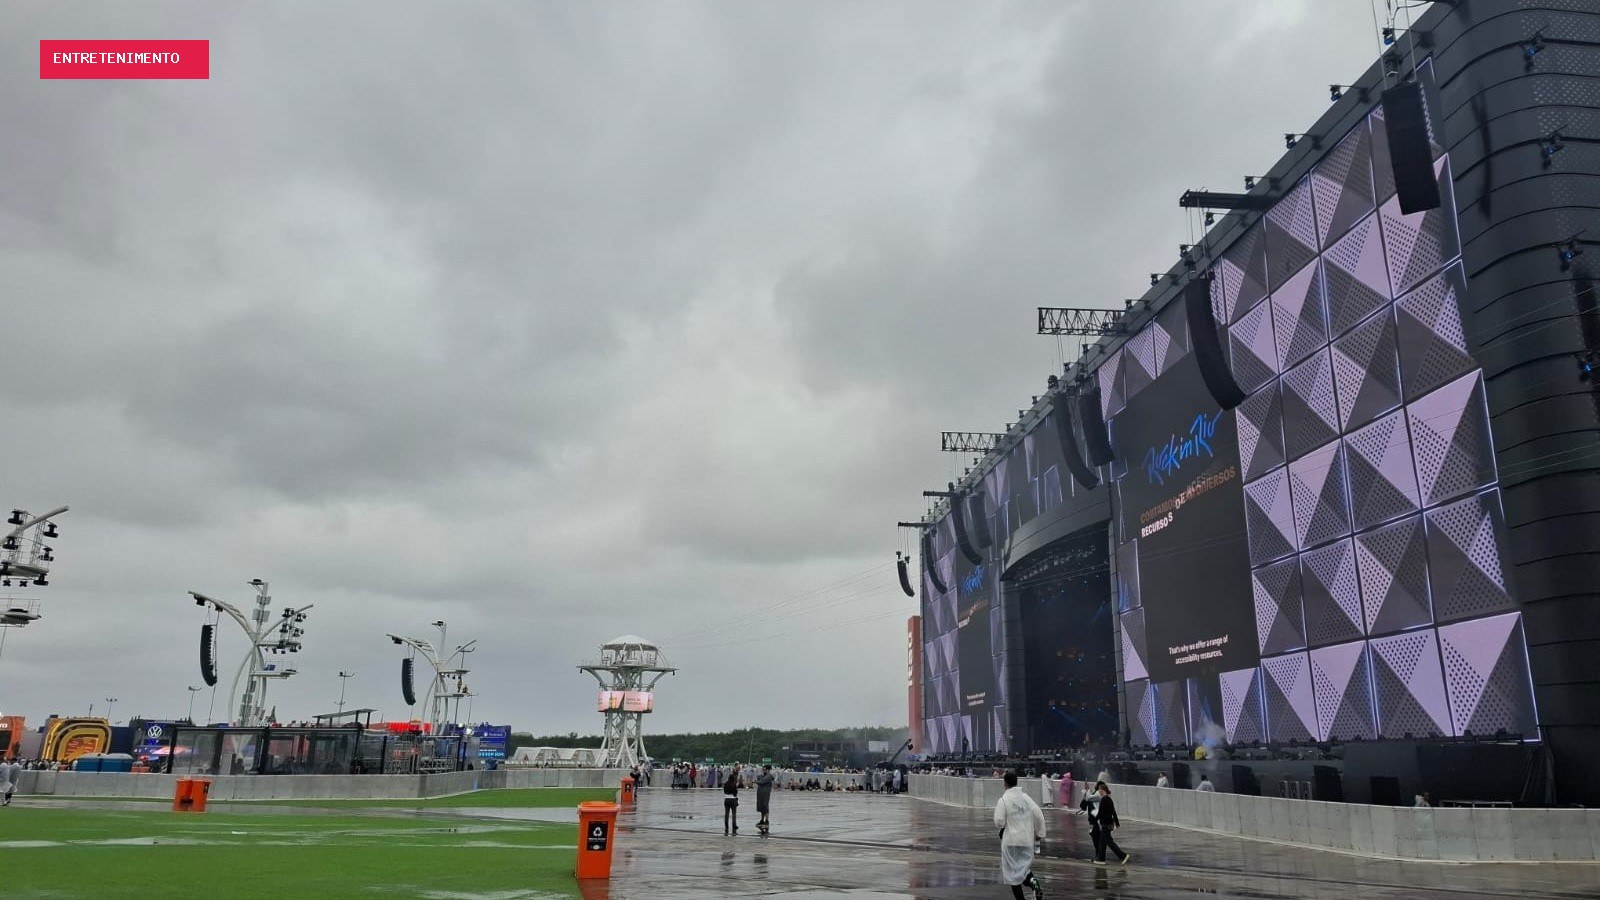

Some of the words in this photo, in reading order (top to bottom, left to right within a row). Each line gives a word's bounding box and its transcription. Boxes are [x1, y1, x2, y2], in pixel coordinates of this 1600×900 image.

[1142, 434, 1180, 485] Rock
[1179, 437, 1193, 460] in
[1189, 408, 1224, 458] Rio
[1141, 512, 1174, 538] RECURSOS
[1169, 647, 1181, 655] That's
[1210, 638, 1222, 646] range
[1175, 654, 1199, 664] accessibility
